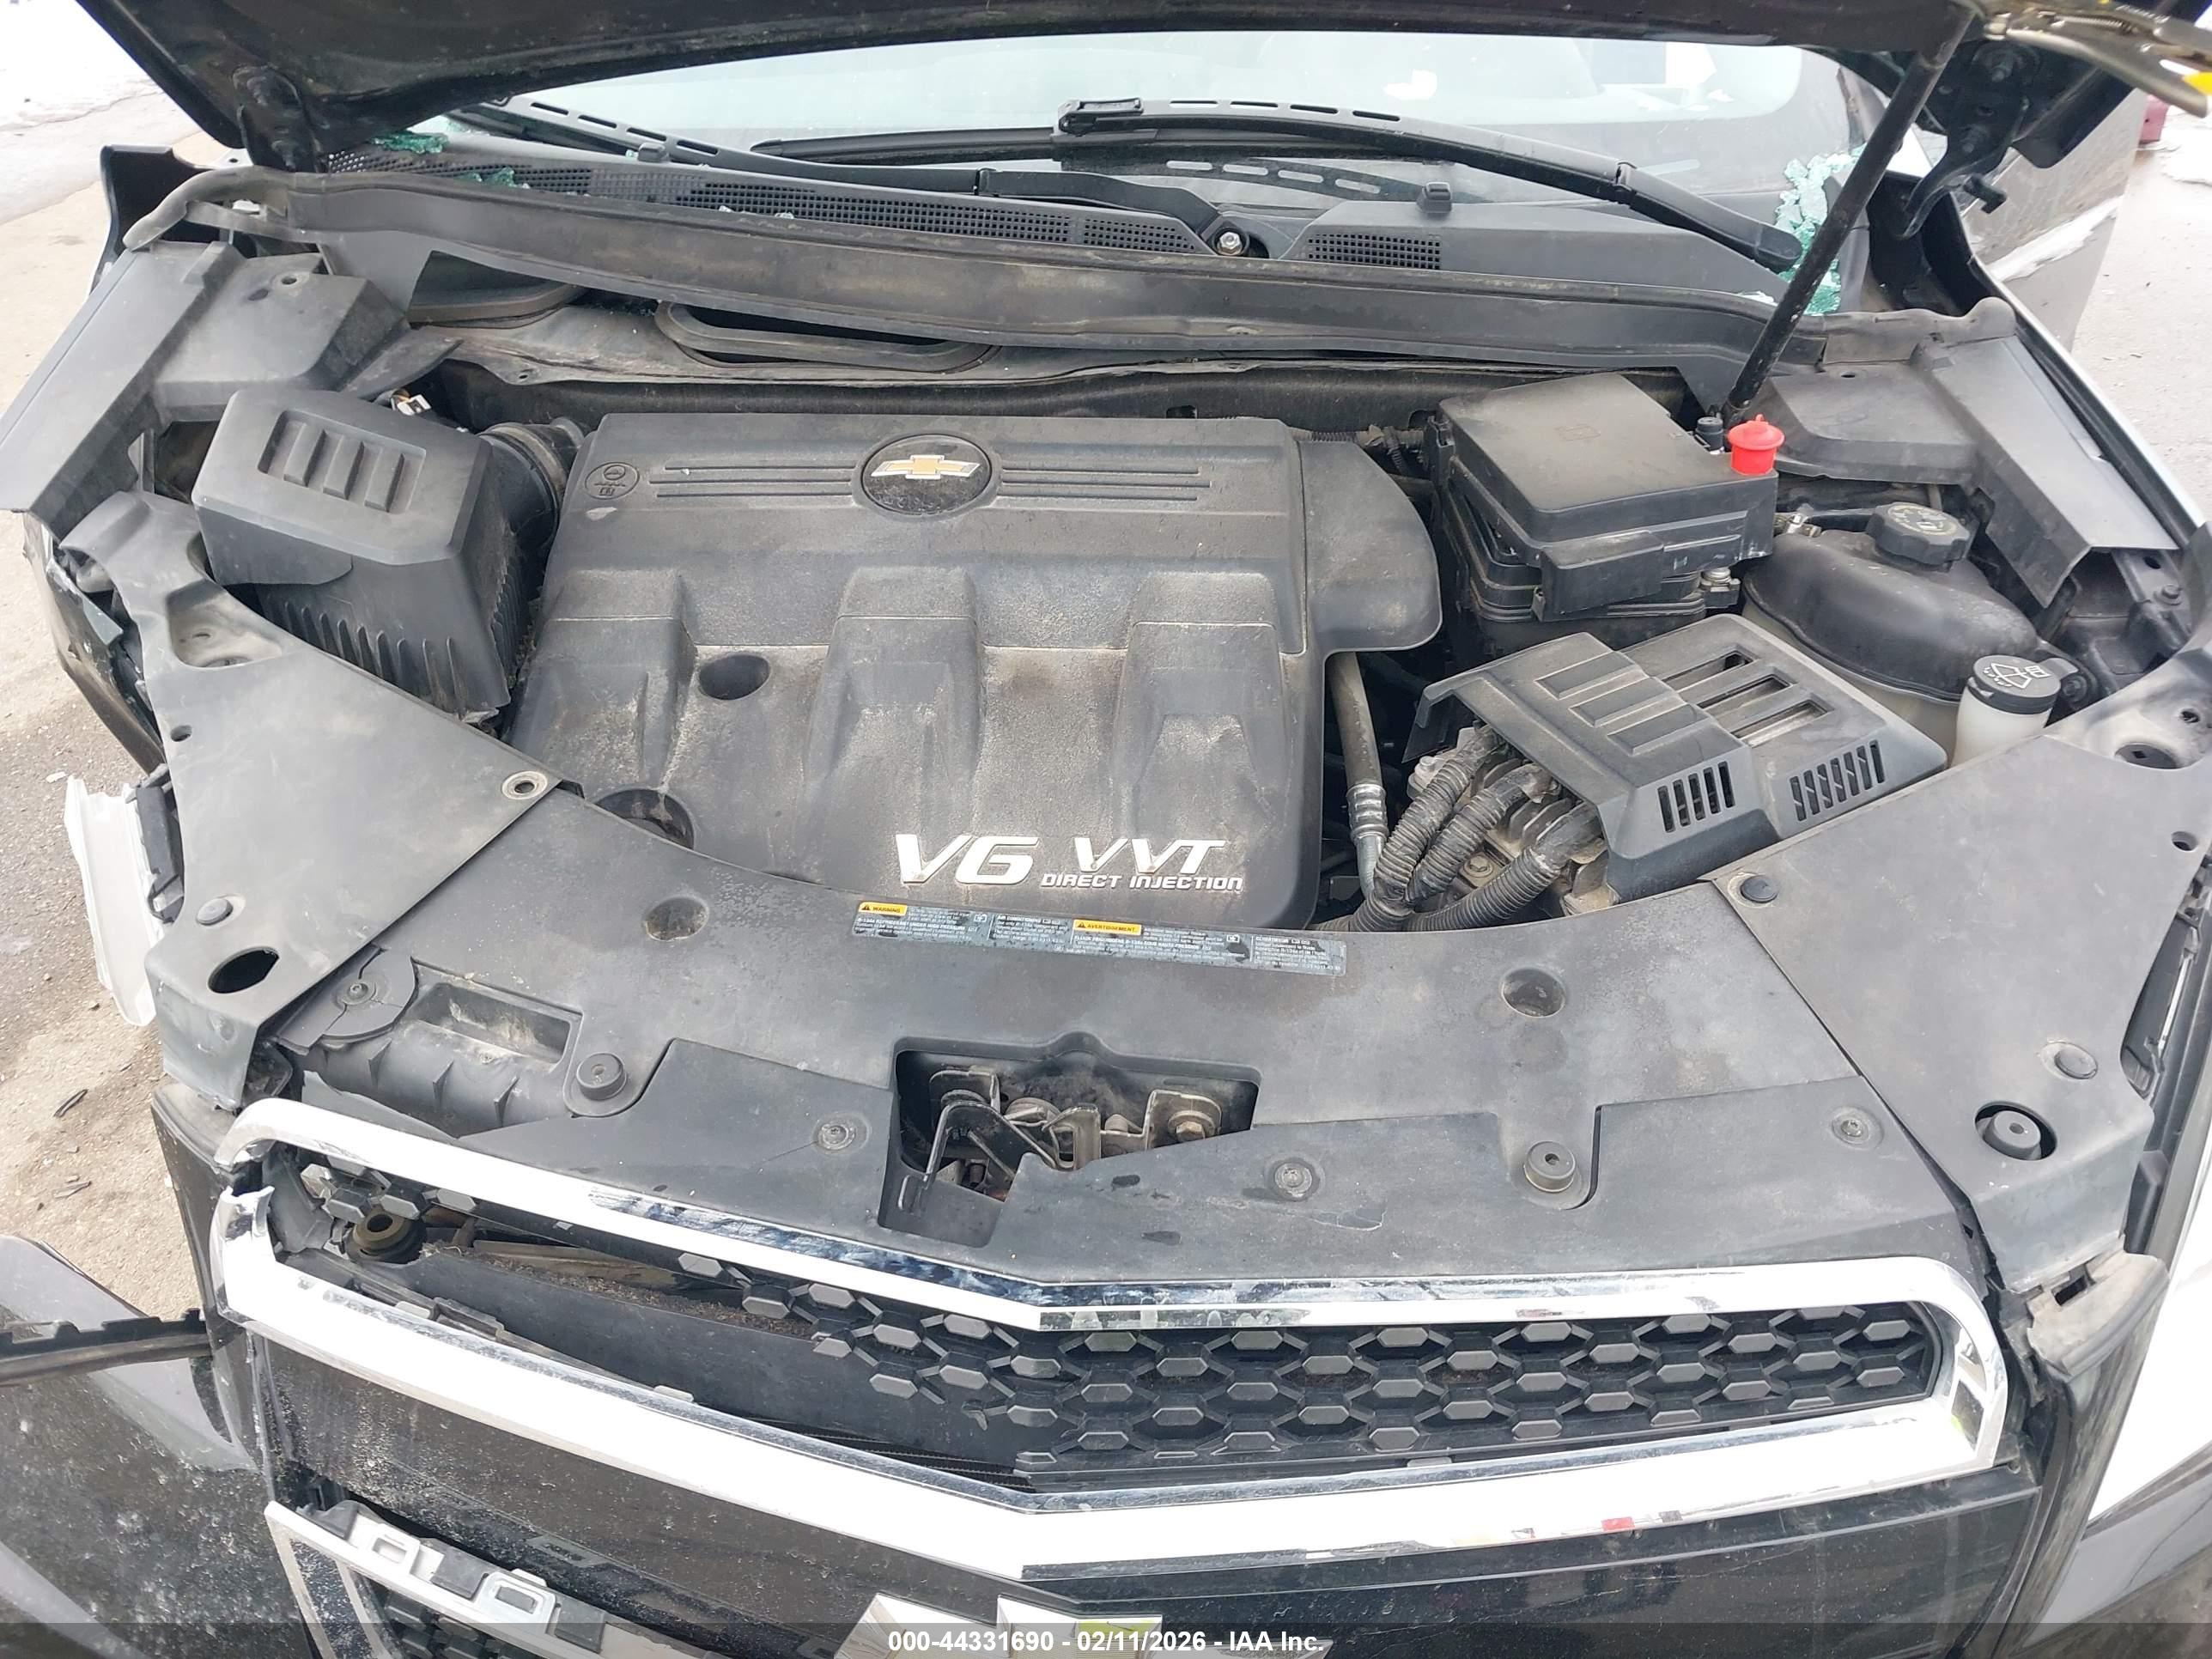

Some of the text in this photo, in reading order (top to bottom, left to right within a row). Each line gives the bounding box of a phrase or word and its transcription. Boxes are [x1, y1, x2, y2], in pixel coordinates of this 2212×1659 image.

[895, 834, 1226, 885] V6 VVT
[1040, 873, 1244, 891] DIRECT INJECTION
[1087, 923, 1135, 933] AVERTISSEMENT
